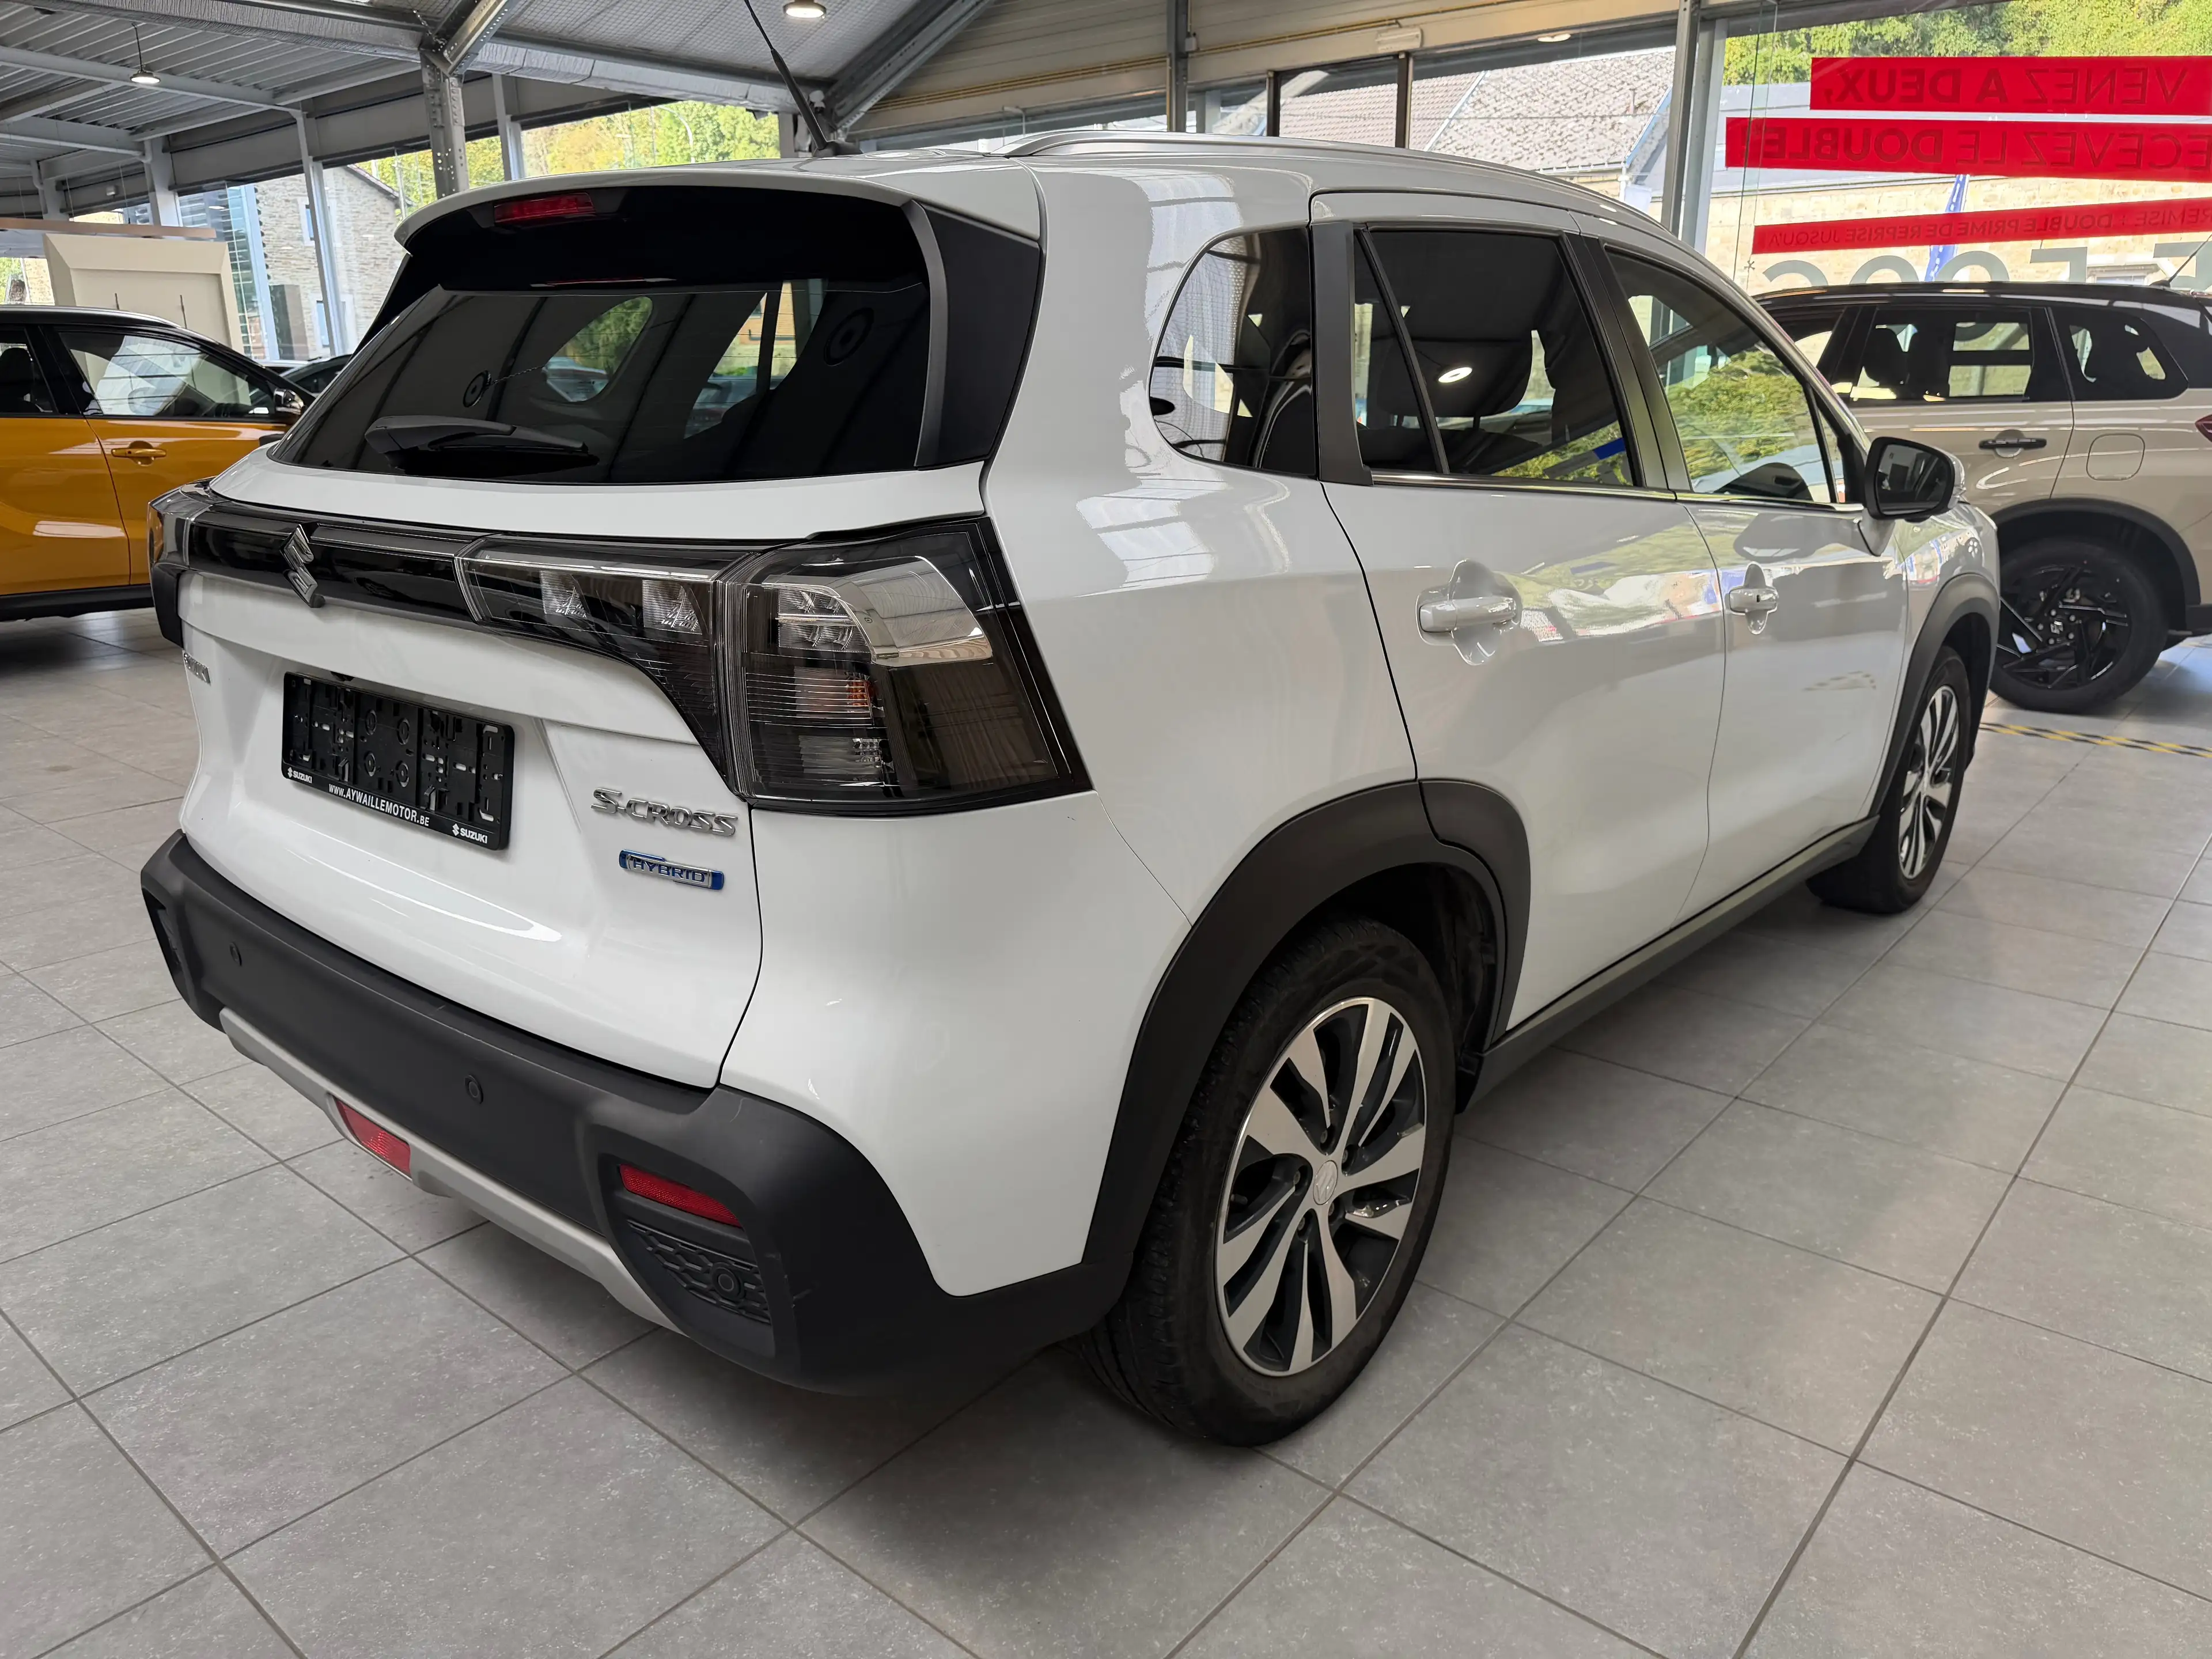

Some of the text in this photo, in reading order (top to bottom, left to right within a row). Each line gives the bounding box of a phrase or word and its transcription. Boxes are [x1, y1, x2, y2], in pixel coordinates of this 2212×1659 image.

[293, 770, 313, 784] SUZUKI
[591, 787, 738, 836] S-CROSS
[460, 828, 488, 844] SUZUKI
[633, 857, 706, 883] HYBRID
